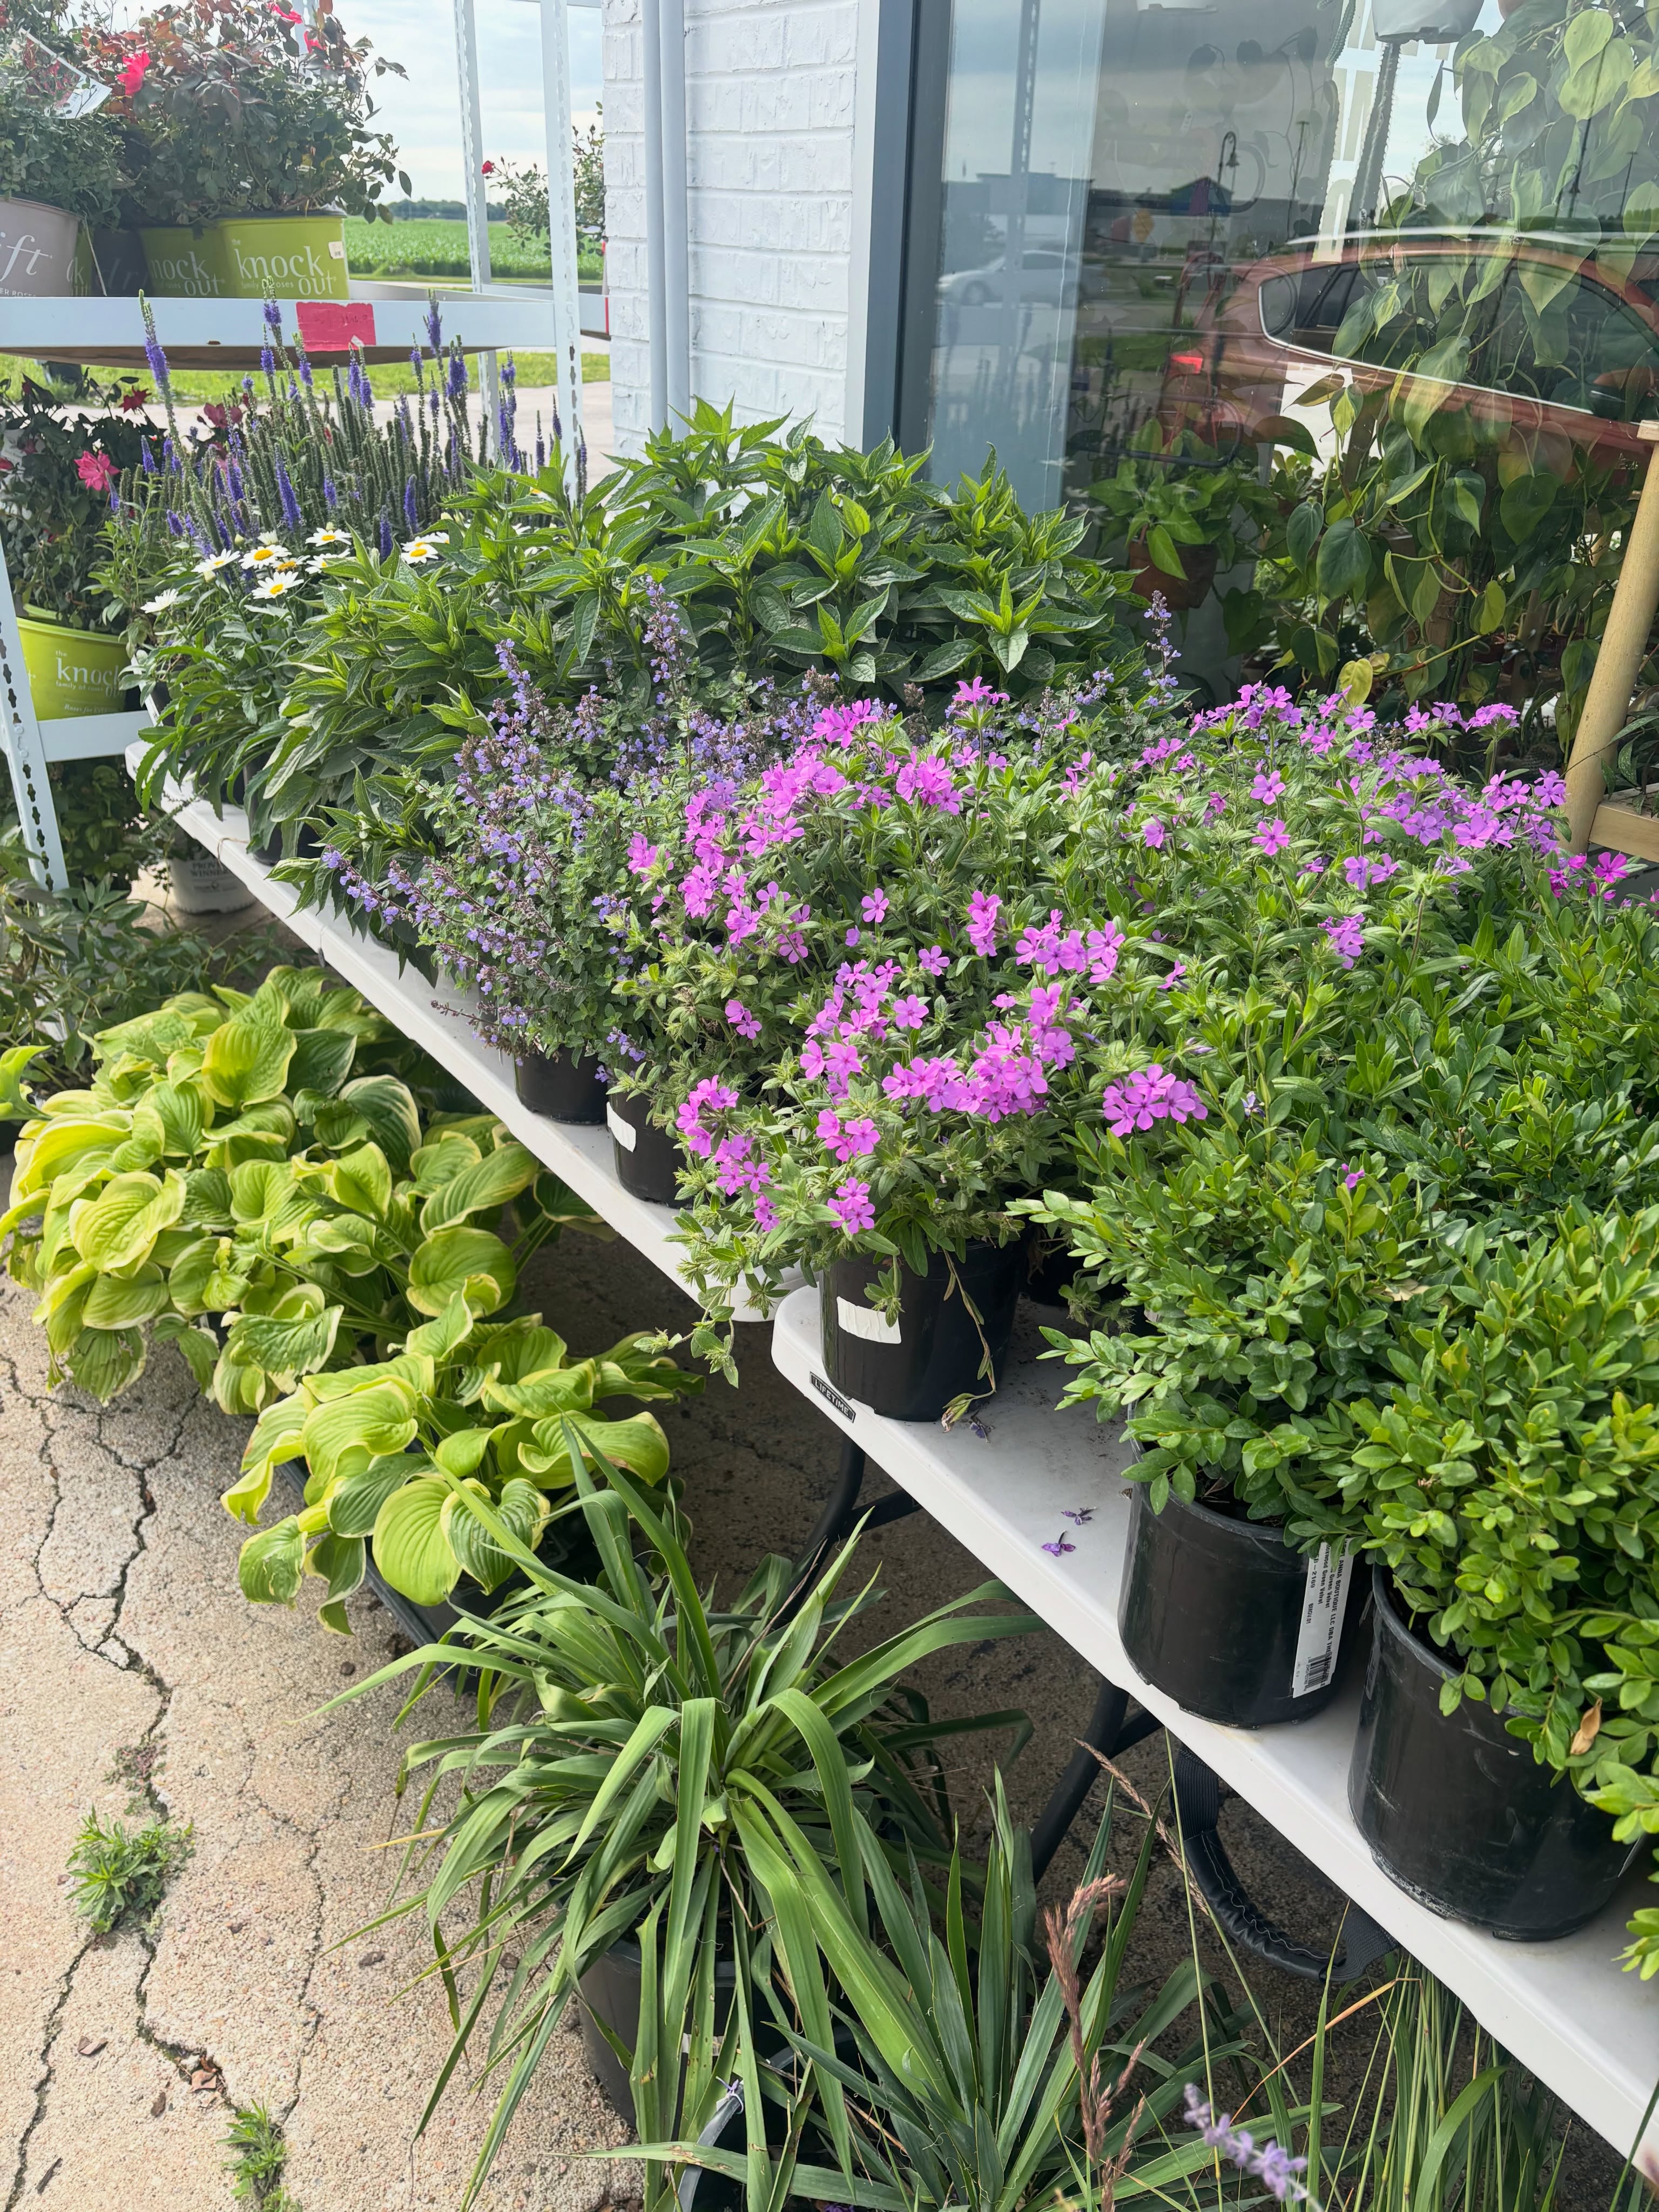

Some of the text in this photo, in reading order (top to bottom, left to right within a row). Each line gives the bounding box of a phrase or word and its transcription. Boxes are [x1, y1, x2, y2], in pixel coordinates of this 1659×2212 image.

[152, 251, 210, 280] nock
[234, 246, 324, 279] knock
[184, 272, 220, 296] out
[298, 270, 333, 295] out
[56, 681, 76, 691] family
[814, 1378, 850, 1417] LIFETIME
[1320, 1569, 1328, 1587] Green
[1317, 1587, 1325, 1605] Velvet
[1325, 1590, 1333, 1609] Velvet
[1331, 1580, 1341, 1613] BOUTIQUE
